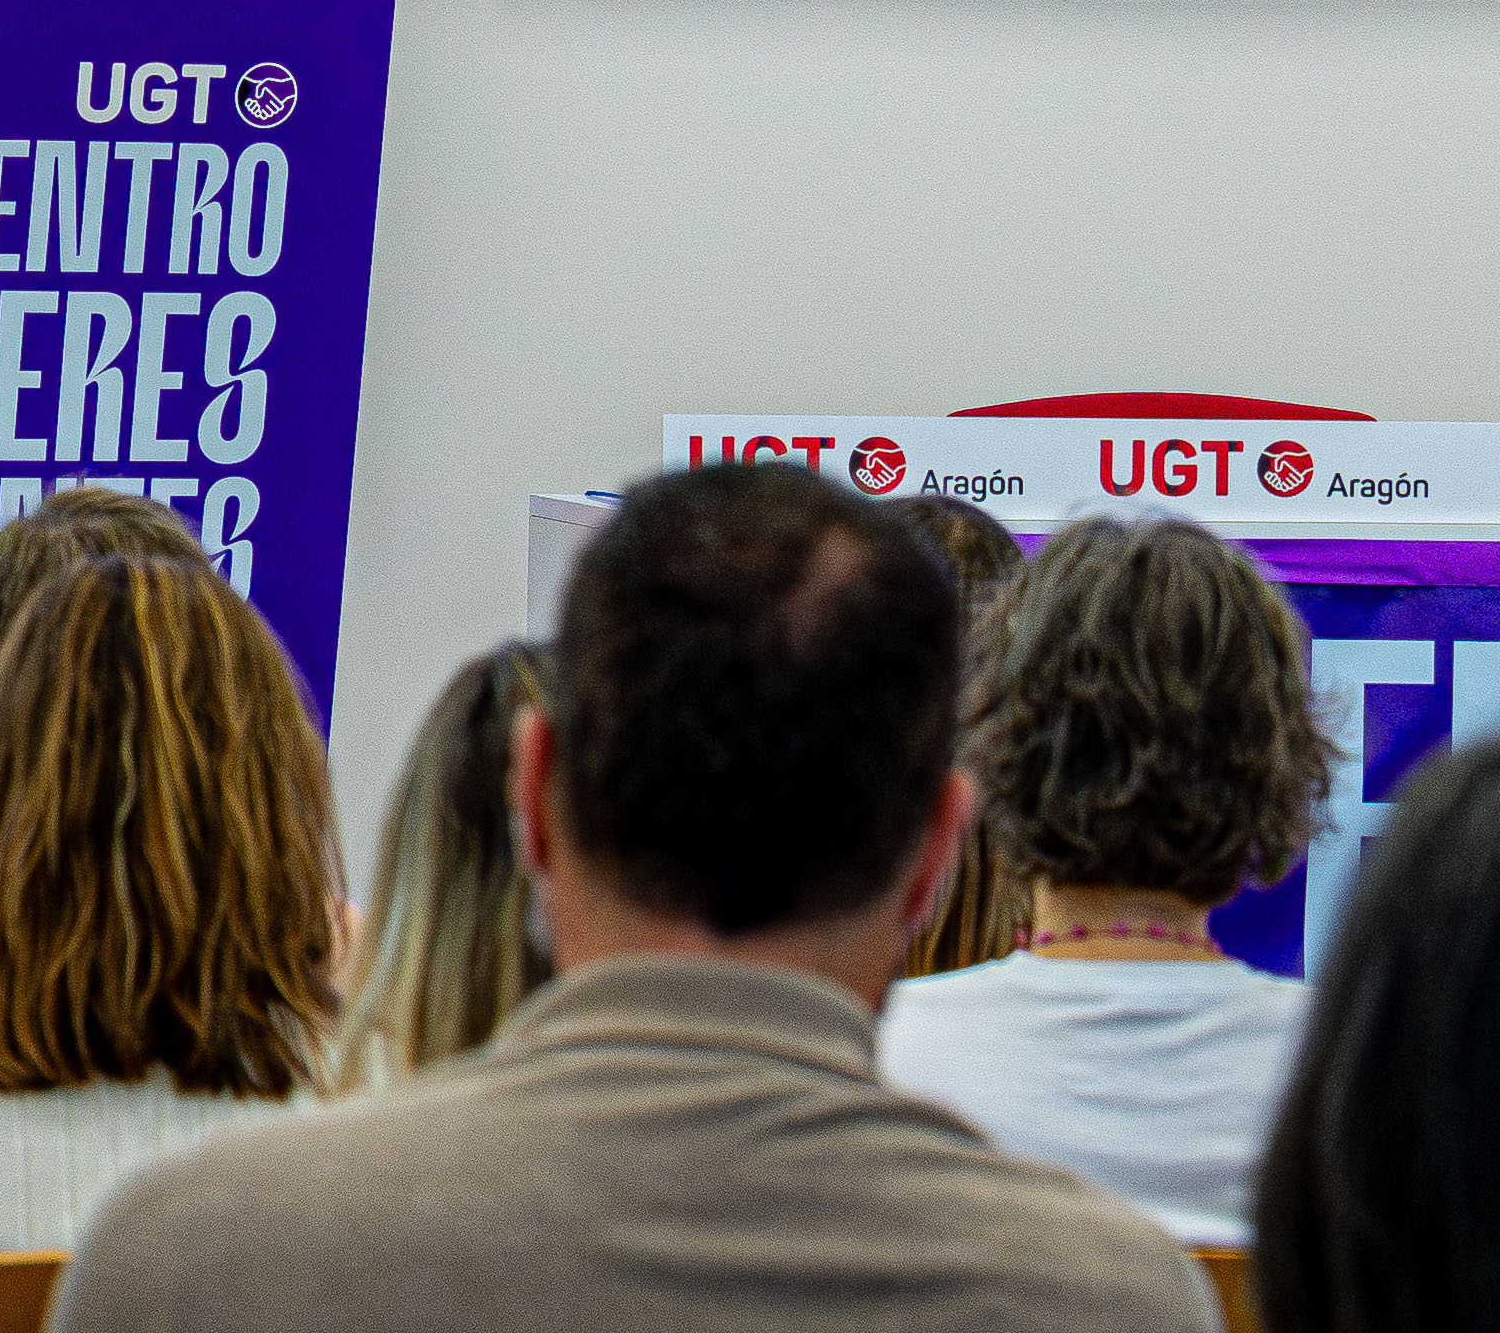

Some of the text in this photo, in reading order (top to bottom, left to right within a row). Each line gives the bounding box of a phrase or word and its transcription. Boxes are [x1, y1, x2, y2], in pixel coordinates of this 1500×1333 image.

[76, 61, 227, 125] UGT
[920, 469, 1024, 502] Aragón
[1099, 439, 1429, 505] UGT Aragón
